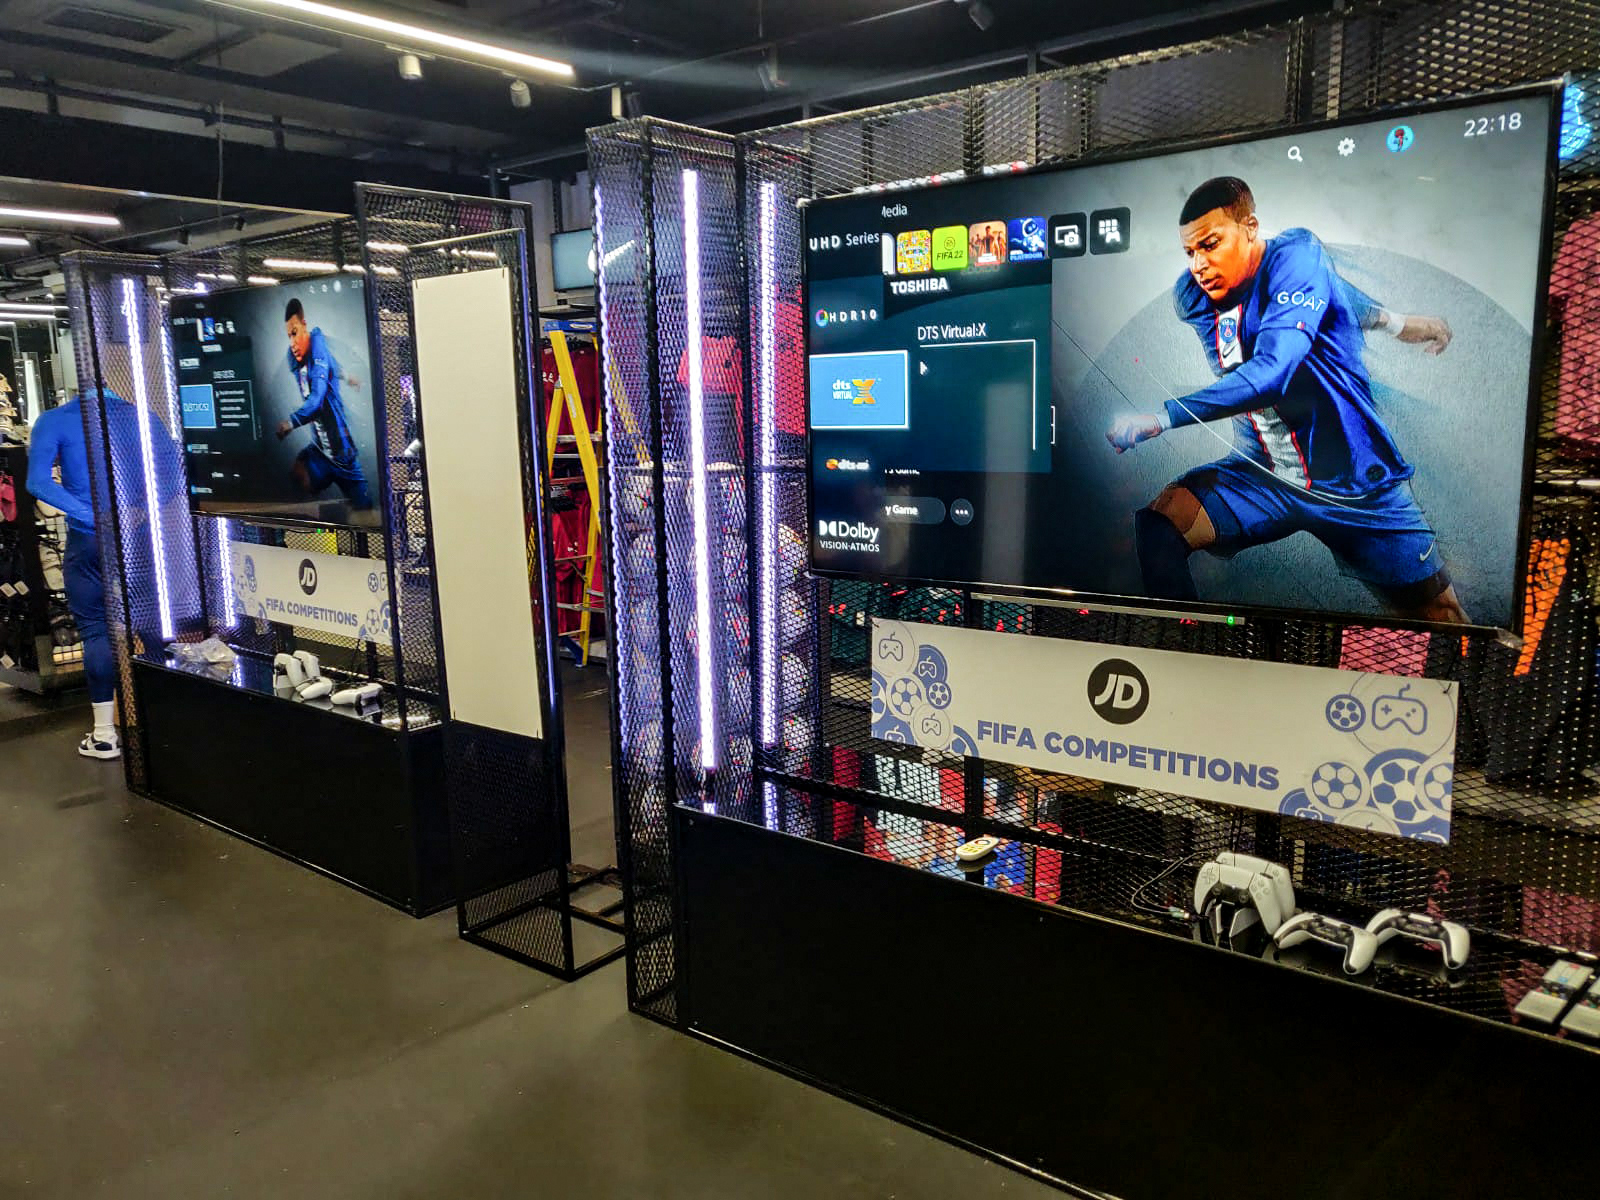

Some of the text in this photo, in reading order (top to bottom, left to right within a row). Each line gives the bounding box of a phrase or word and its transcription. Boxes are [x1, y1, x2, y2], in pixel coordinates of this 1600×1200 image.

[1464, 112, 1522, 138] 22:18
[809, 232, 880, 251] UHD Series
[936, 251, 953, 261] FIFA
[954, 250, 964, 259] 22
[890, 277, 949, 295] TOSHIBA
[1277, 291, 1326, 312] GOAT
[829, 309, 877, 323] HDR10
[917, 325, 939, 341] DTS
[832, 379, 851, 390] dts
[892, 504, 919, 515] Game
[838, 521, 879, 543] Dolby
[301, 566, 316, 587] JD
[265, 597, 358, 627] FIFA COMPETITIONS
[1094, 673, 1142, 710] JD
[977, 719, 1280, 791] FIFA COMPETITIONS
